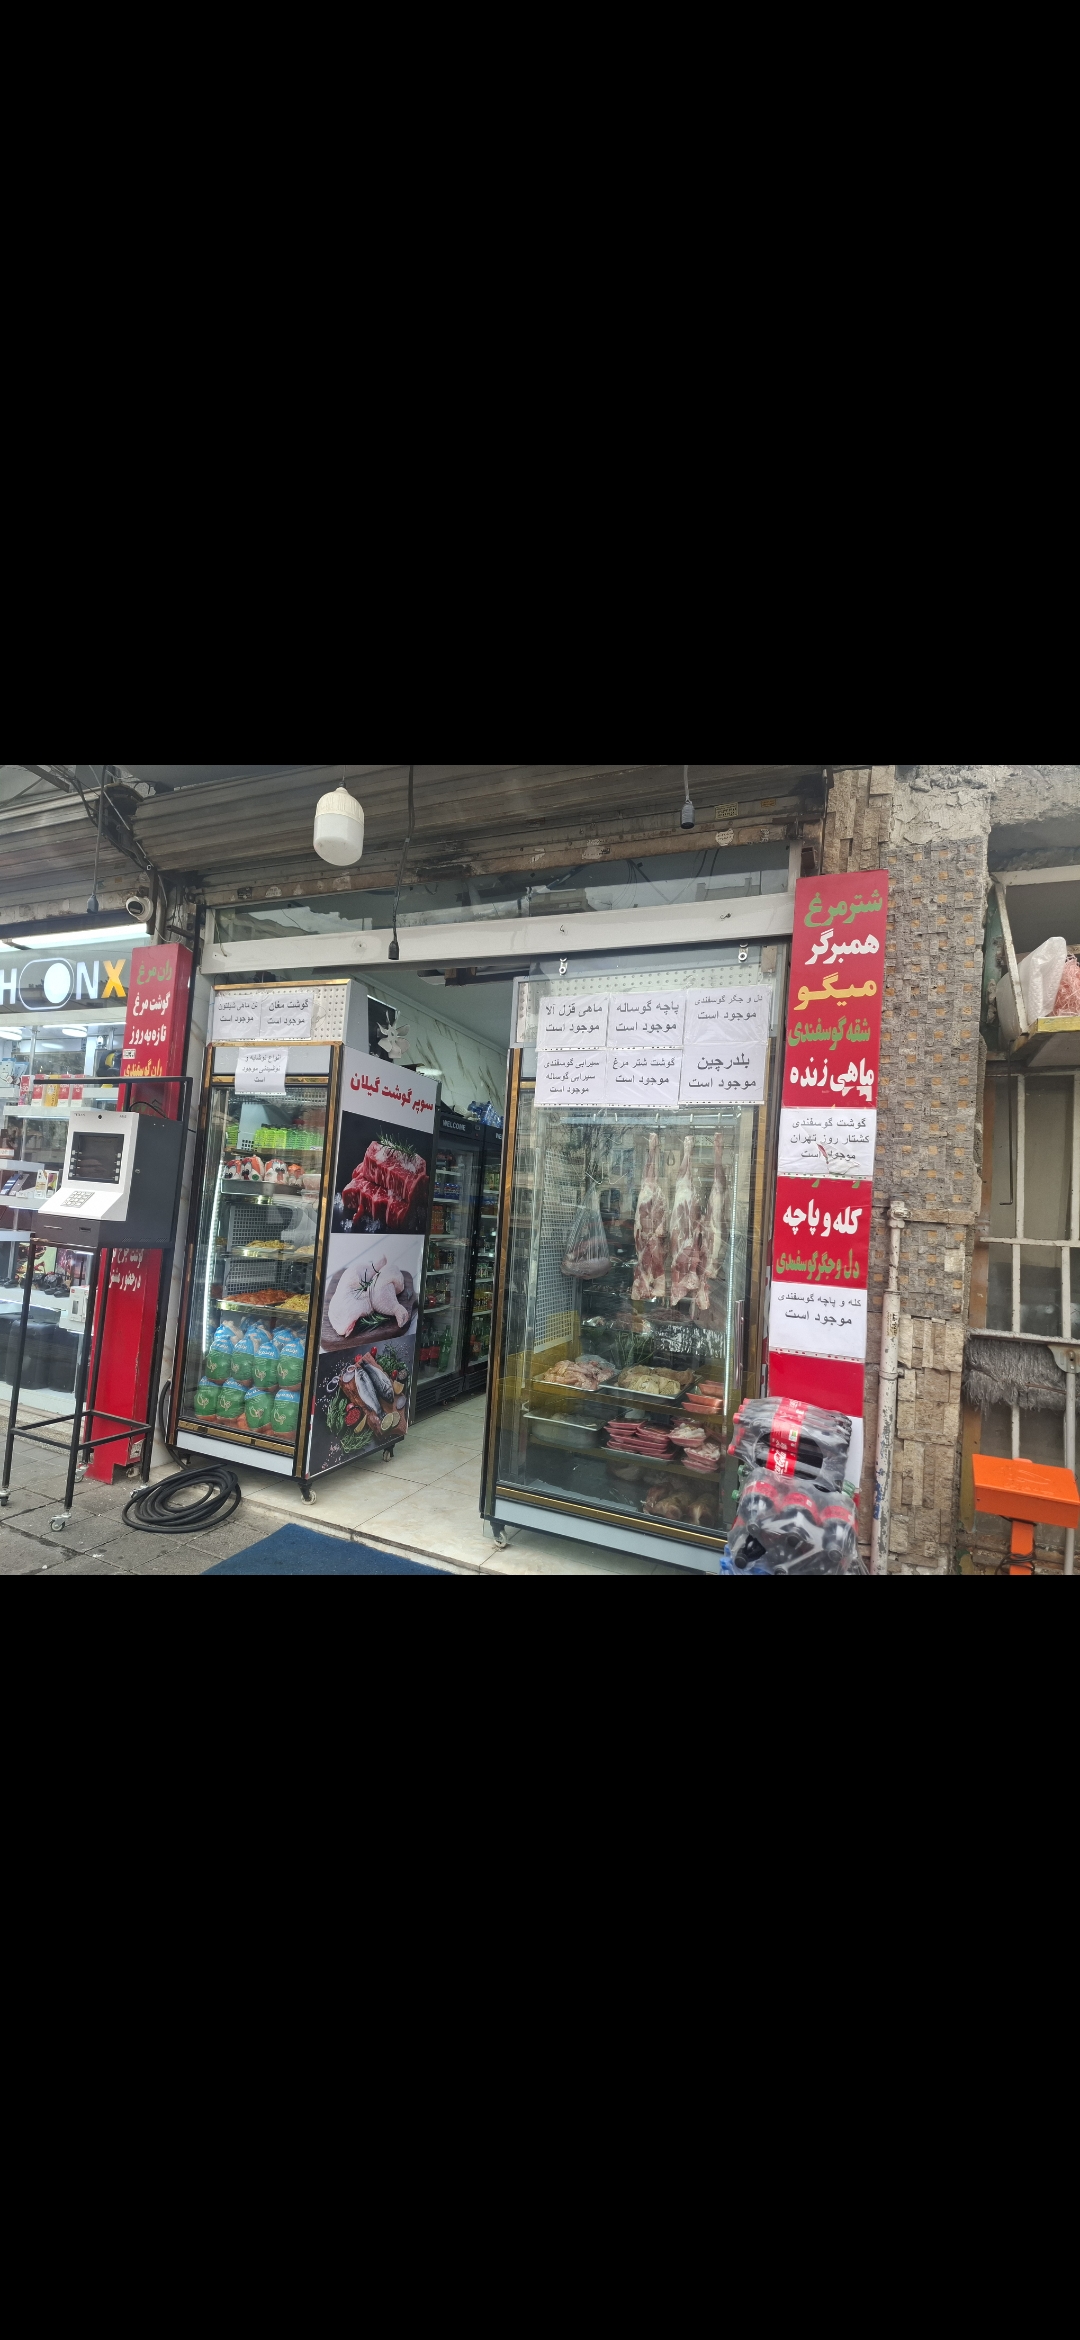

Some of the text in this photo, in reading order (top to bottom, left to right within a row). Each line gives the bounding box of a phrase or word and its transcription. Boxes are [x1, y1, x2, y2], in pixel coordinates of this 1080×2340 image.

[804, 889, 883, 927] شترمرغ
[805, 928, 880, 965] همبرگر
[137, 960, 172, 984] ران مرغ
[794, 972, 877, 1011] میگو
[133, 992, 170, 1016] گوشت مرغ
[269, 999, 308, 1010] گوشت مغان
[695, 995, 726, 1005] گوسفندی
[729, 996, 743, 1004] جگر
[546, 1003, 602, 1016] ماهی قزل آلا
[617, 1000, 679, 1014] پاچه گوساله
[698, 1010, 756, 1020] موجود است
[546, 1023, 599, 1034] موجود است
[616, 1022, 677, 1033] موجود است
[788, 1016, 871, 1050] شقه گوسفندی
[129, 1025, 166, 1046] تازه به روز
[544, 1058, 599, 1069] سیرابی گوسفندی
[613, 1057, 675, 1069] گوشت شتر مرغ
[698, 1053, 750, 1071] بلدرچین
[124, 1061, 152, 1076] گوسفندی
[790, 1057, 874, 1091] ماهی زنده
[546, 1072, 595, 1081] سیرابی گوساله
[616, 1075, 669, 1085] موجود است
[550, 1085, 589, 1094] موجود است
[689, 1078, 756, 1089] موجود است
[350, 1073, 433, 1114] سوپر گوشت گیلان
[443, 1120, 466, 1131] WELCOME
[792, 1117, 866, 1130] گوشت گوسفندی
[790, 1134, 869, 1146] کشتار روز تهران
[801, 1150, 855, 1161] موجود است
[783, 1199, 862, 1237] کله و پاچه
[776, 1249, 859, 1281] دل و جگر گوسفندی
[778, 1292, 814, 1304] گوسفندی
[817, 1296, 835, 1307] پاچه
[847, 1297, 861, 1307] کله
[785, 1309, 852, 1325] موجود است
